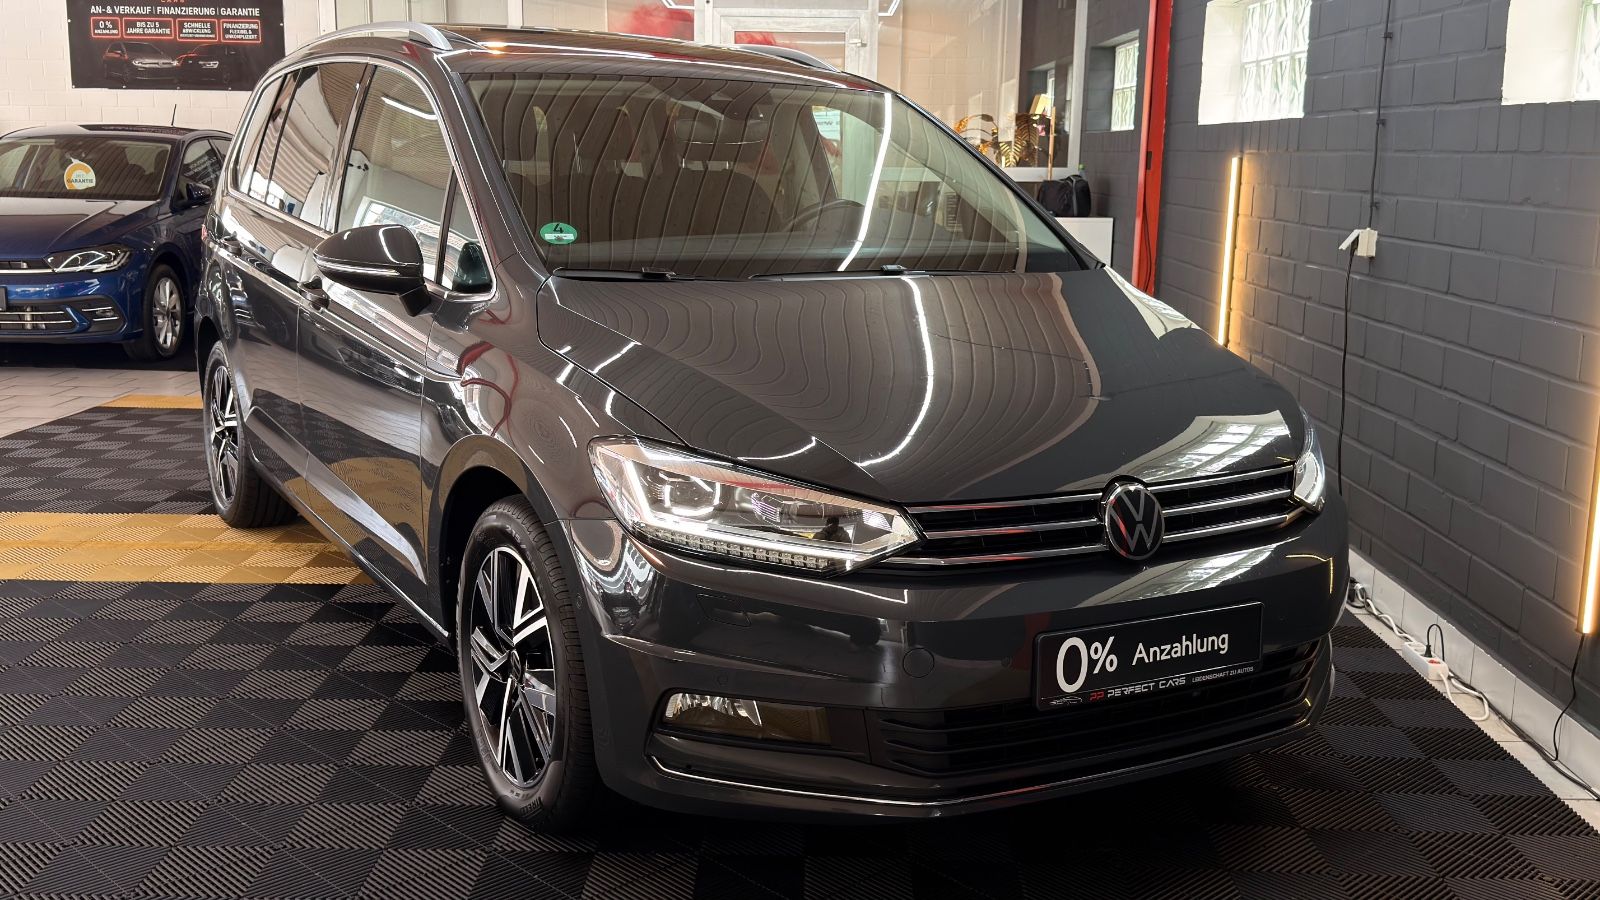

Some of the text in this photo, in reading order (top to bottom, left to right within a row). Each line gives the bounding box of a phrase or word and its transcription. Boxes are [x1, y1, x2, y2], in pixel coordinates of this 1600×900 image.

[114, 6, 152, 14] VERKAUF
[156, 6, 216, 15] FINANZIERUNG
[220, 8, 260, 16] GARANTIE
[106, 20, 112, 28] %
[553, 224, 564, 233] 4
[1132, 633, 1229, 666] Anzahlung
[1108, 682, 1156, 698] PERFECT
[1159, 677, 1186, 688] CARS
